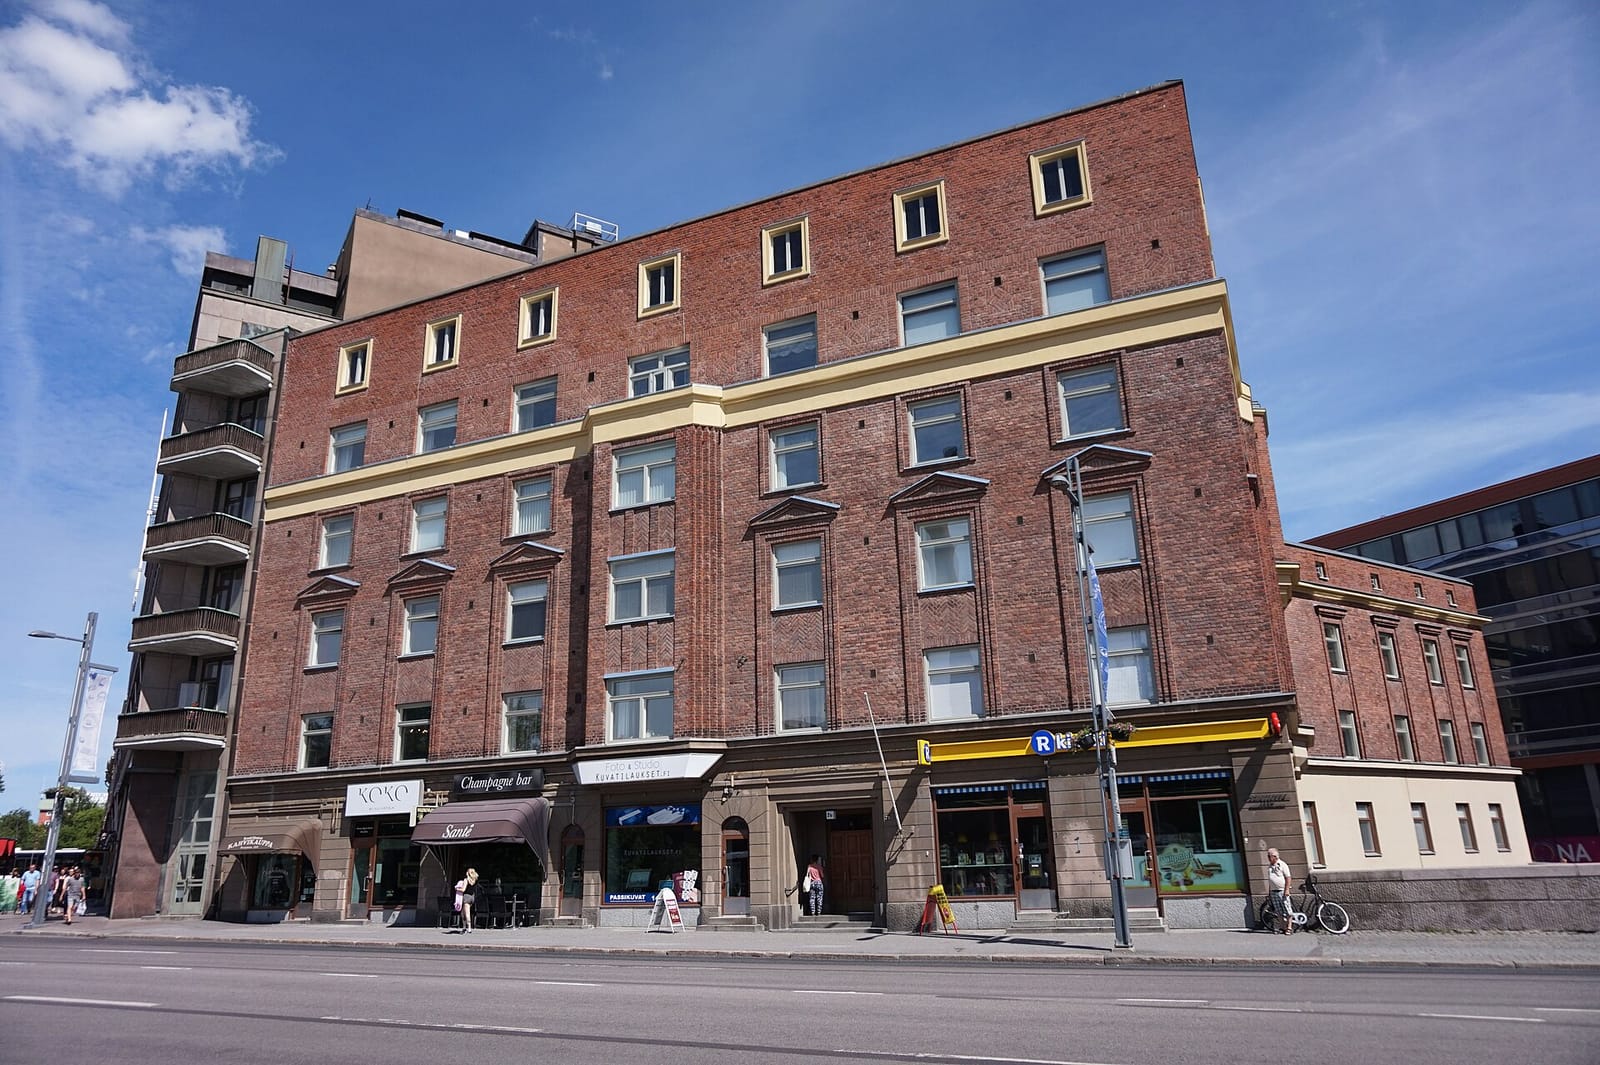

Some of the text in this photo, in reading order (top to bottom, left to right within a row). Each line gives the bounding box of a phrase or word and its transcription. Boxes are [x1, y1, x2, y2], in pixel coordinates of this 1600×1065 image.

[605, 763, 625, 771] Foto
[634, 760, 660, 769] Studio
[461, 773, 533, 791] Champagne bar
[359, 784, 409, 803] KOKO
[442, 824, 474, 838] Santé
